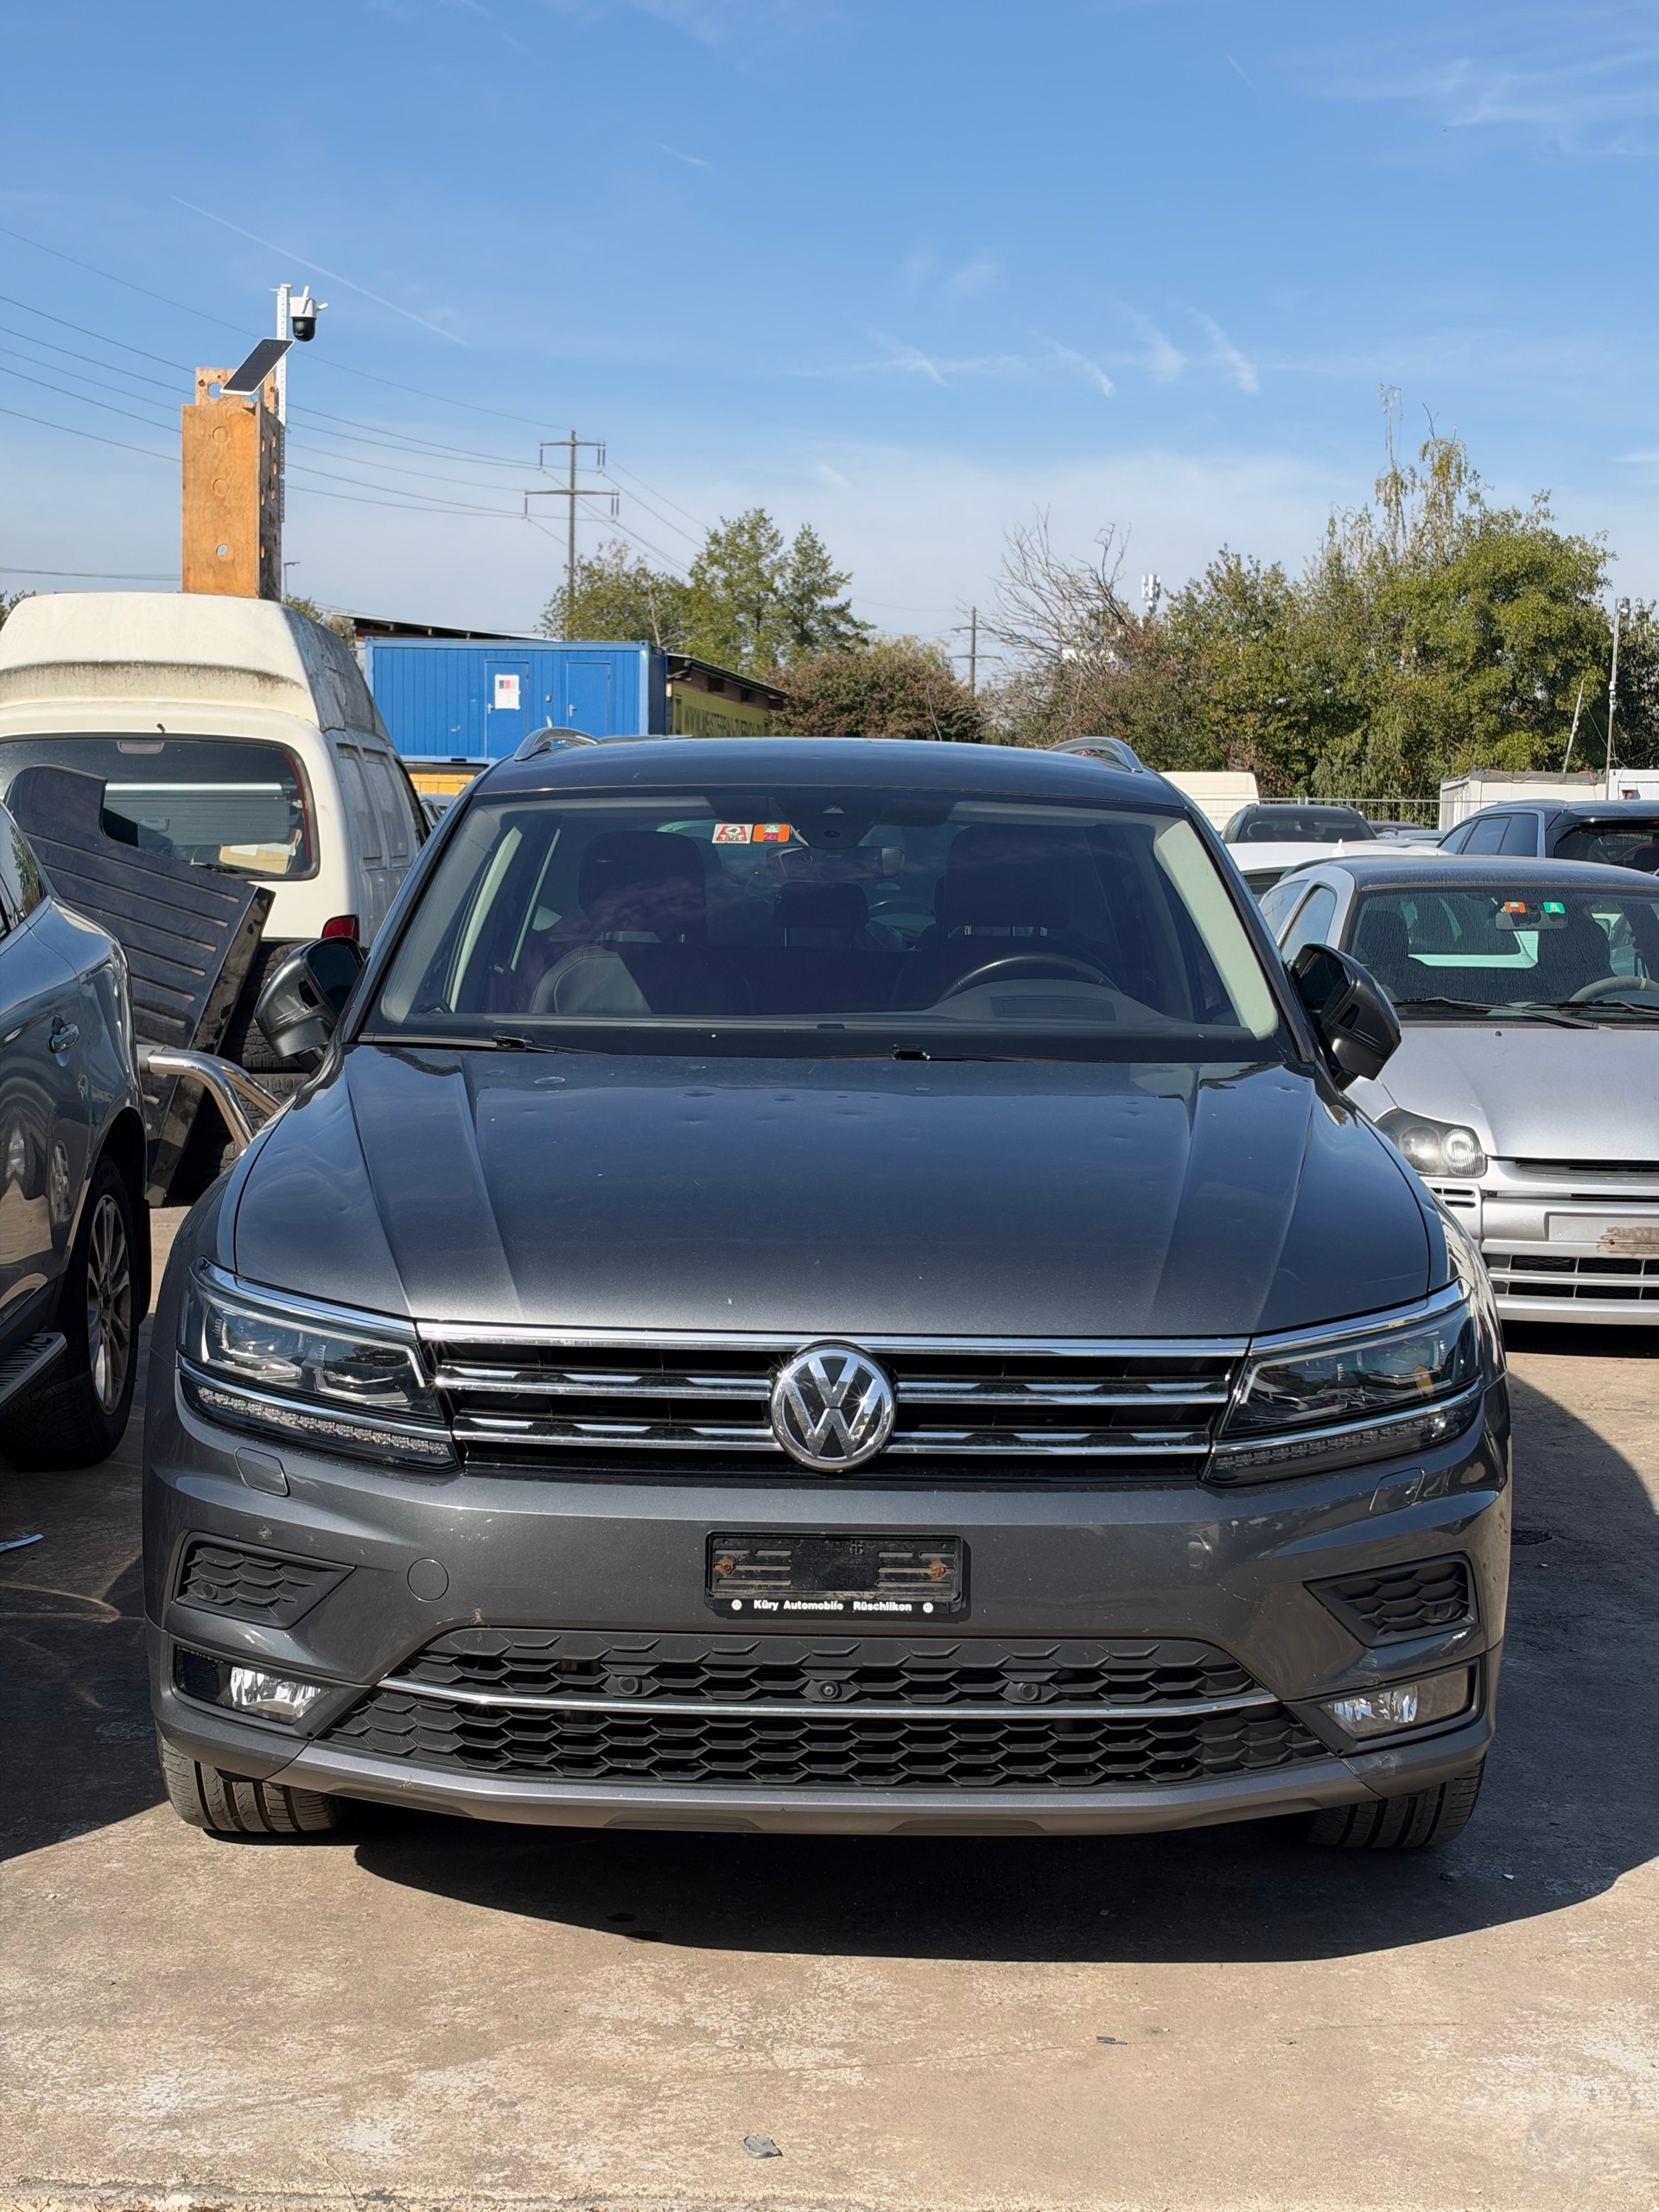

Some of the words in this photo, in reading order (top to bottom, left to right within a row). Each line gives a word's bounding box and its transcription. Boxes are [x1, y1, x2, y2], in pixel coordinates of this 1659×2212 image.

[775, 1347, 891, 1468] VW
[753, 1599, 779, 1611] Küry
[853, 1601, 912, 1611] Rüschlikon
